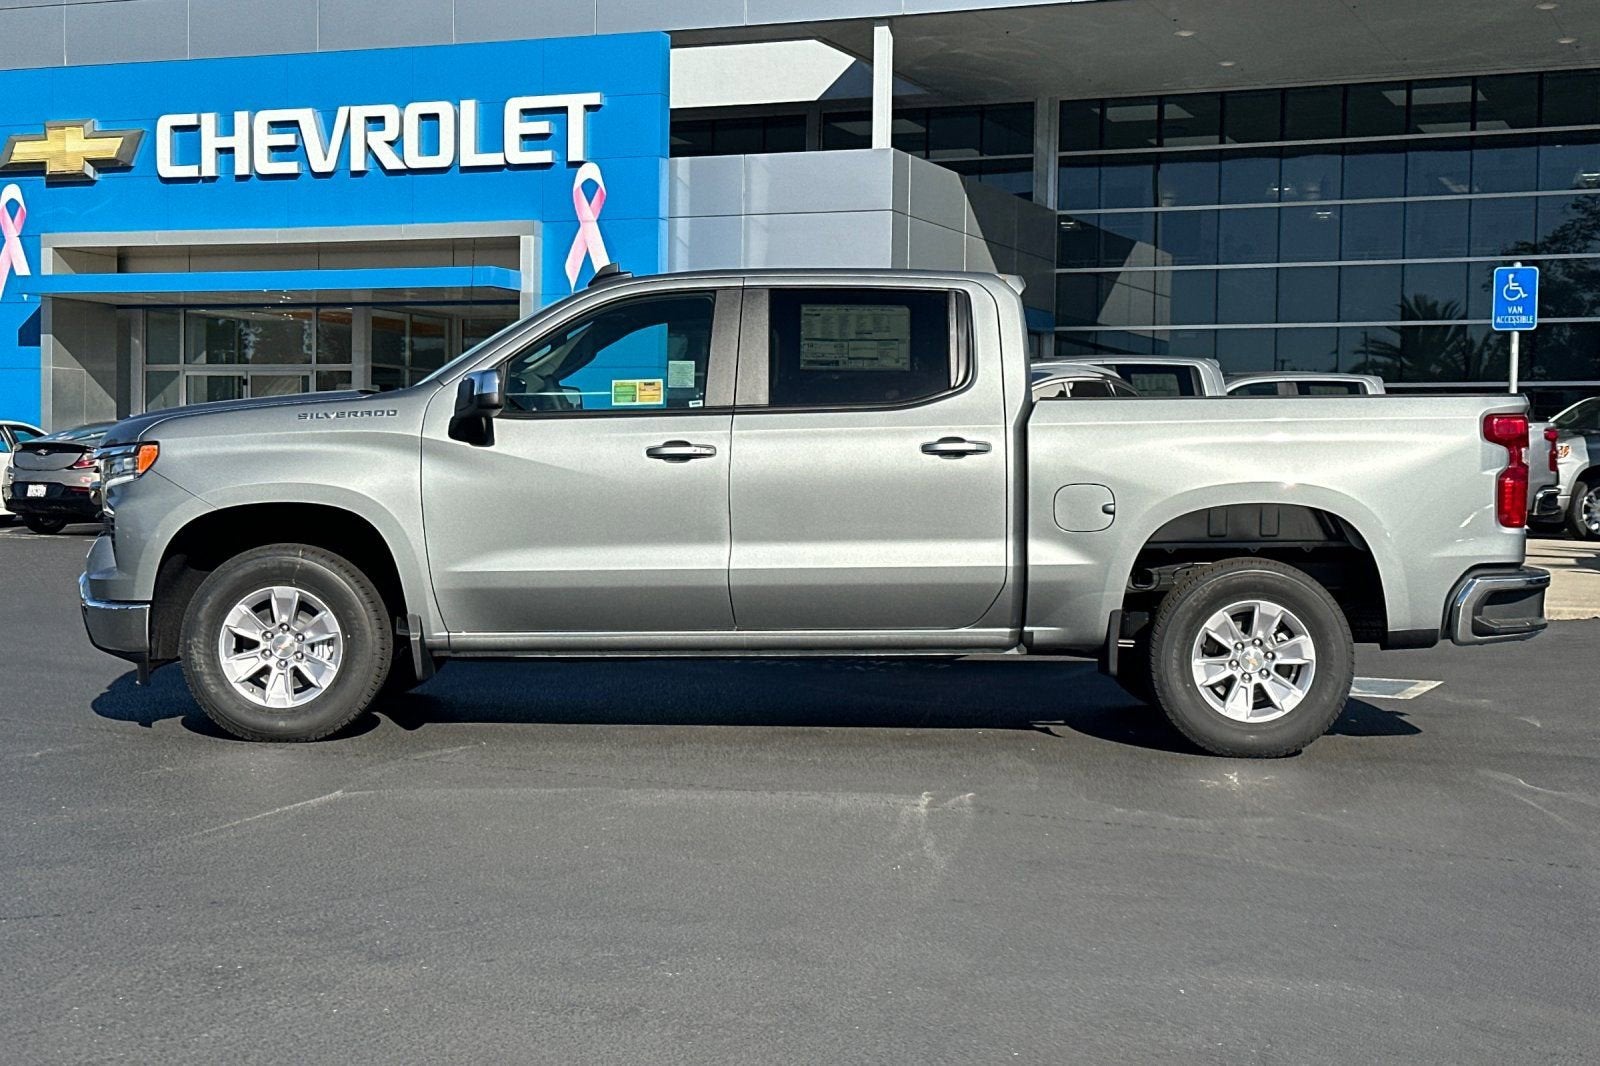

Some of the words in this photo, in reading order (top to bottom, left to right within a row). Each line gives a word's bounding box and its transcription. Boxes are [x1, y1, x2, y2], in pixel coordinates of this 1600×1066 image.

[156, 92, 602, 179] CHEVROLET
[1507, 305, 1523, 314] VAN
[1496, 315, 1534, 324] ACCESSIBLE
[297, 409, 398, 420] SILVERADO
